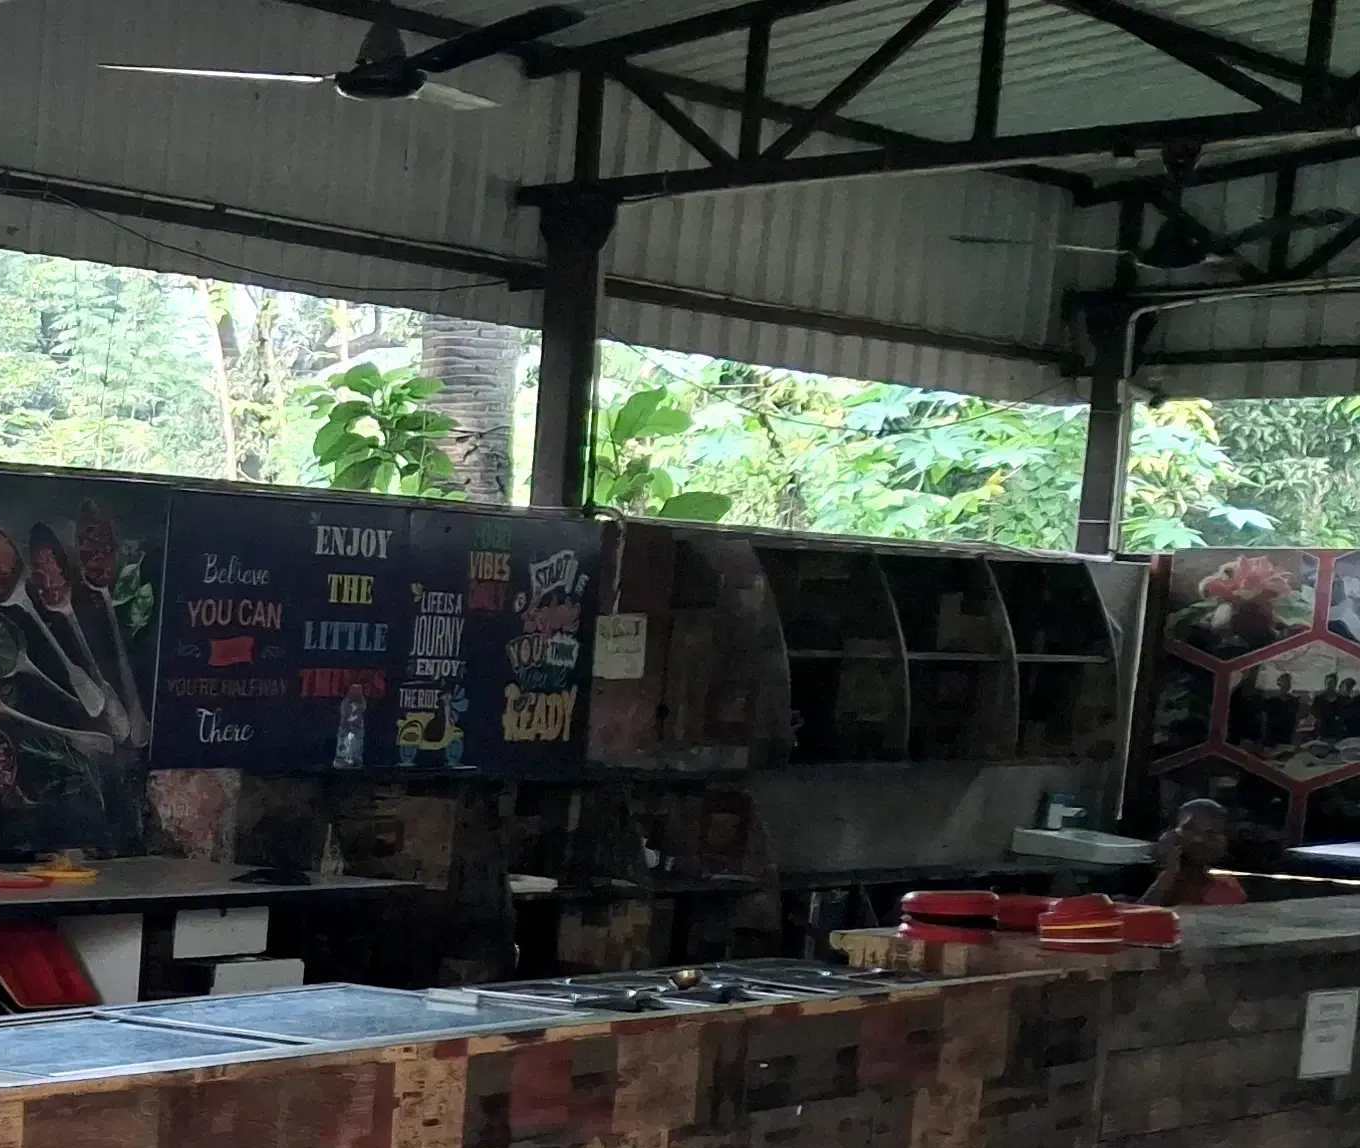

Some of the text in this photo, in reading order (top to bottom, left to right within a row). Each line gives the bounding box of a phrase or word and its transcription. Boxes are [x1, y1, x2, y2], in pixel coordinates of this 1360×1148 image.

[315, 525, 393, 559] ENJOY
[203, 552, 269, 585] Believe
[470, 550, 511, 581] VIBES
[328, 573, 374, 604] THE
[421, 591, 444, 613] LIFE
[188, 599, 282, 630] YOU CAN
[304, 620, 389, 652] LITTLE
[409, 616, 465, 657] JOURNY
[415, 659, 461, 680] ENJOY
[196, 707, 255, 743] There
